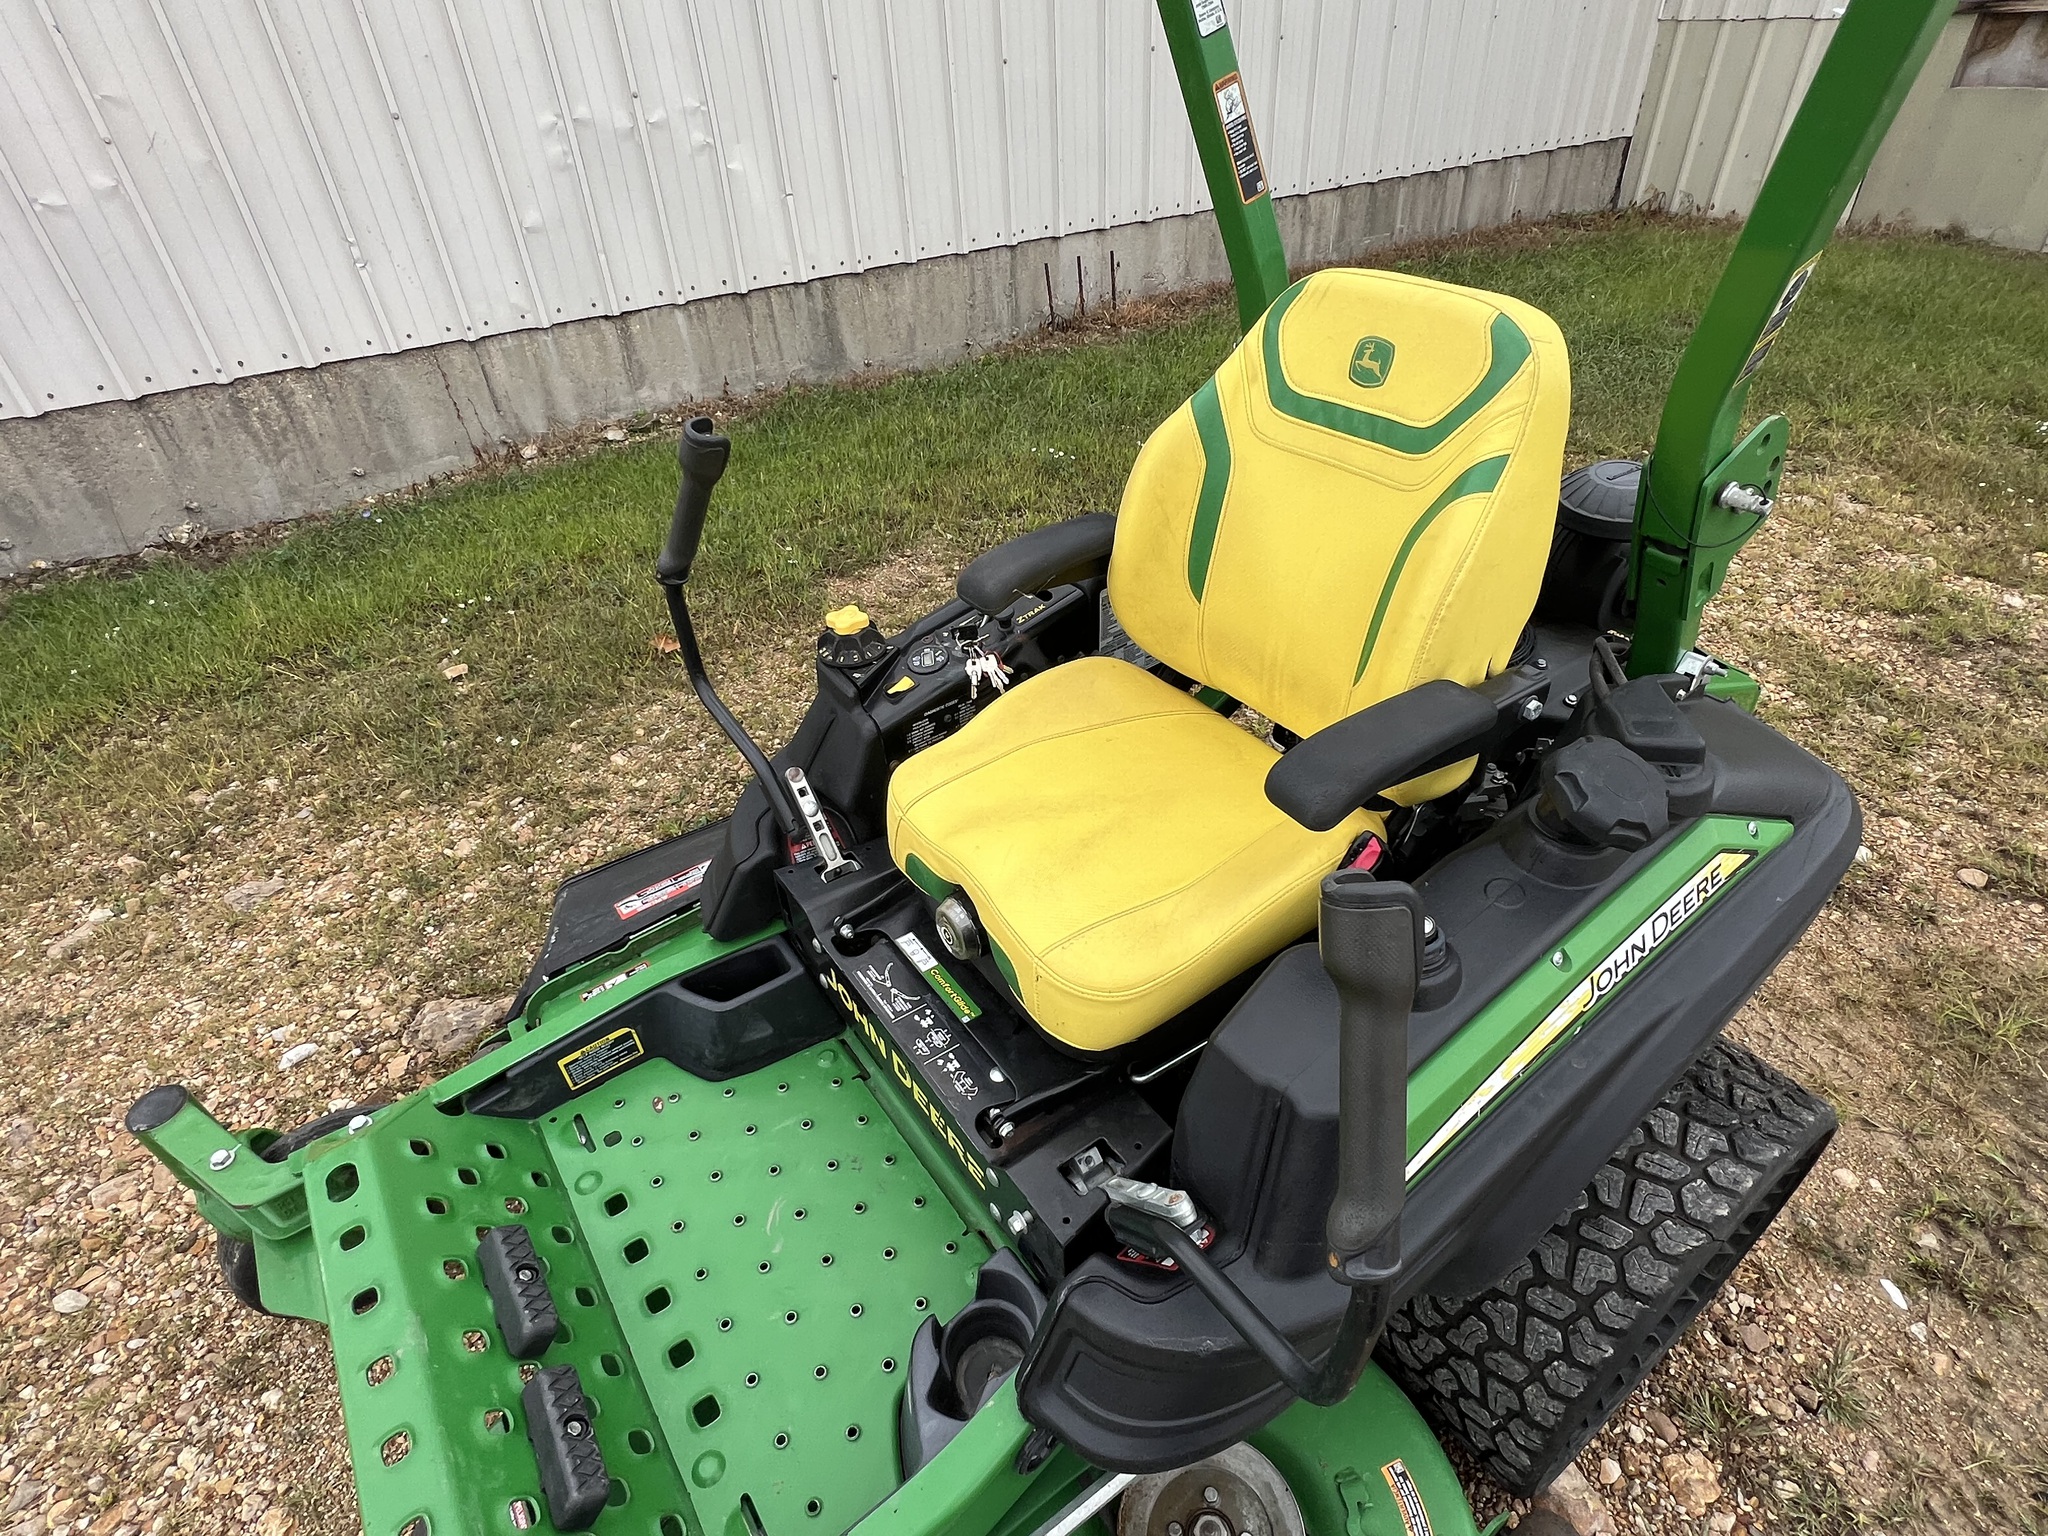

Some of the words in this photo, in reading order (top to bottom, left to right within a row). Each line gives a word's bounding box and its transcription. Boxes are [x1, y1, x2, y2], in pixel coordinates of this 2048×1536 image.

[1016, 603, 1046, 624] ZTRAK
[1583, 934, 1646, 1009] JOHN
[1652, 863, 1722, 943] DEERE
[827, 968, 887, 1059] JOHN
[892, 1049, 986, 1190] DEERE
